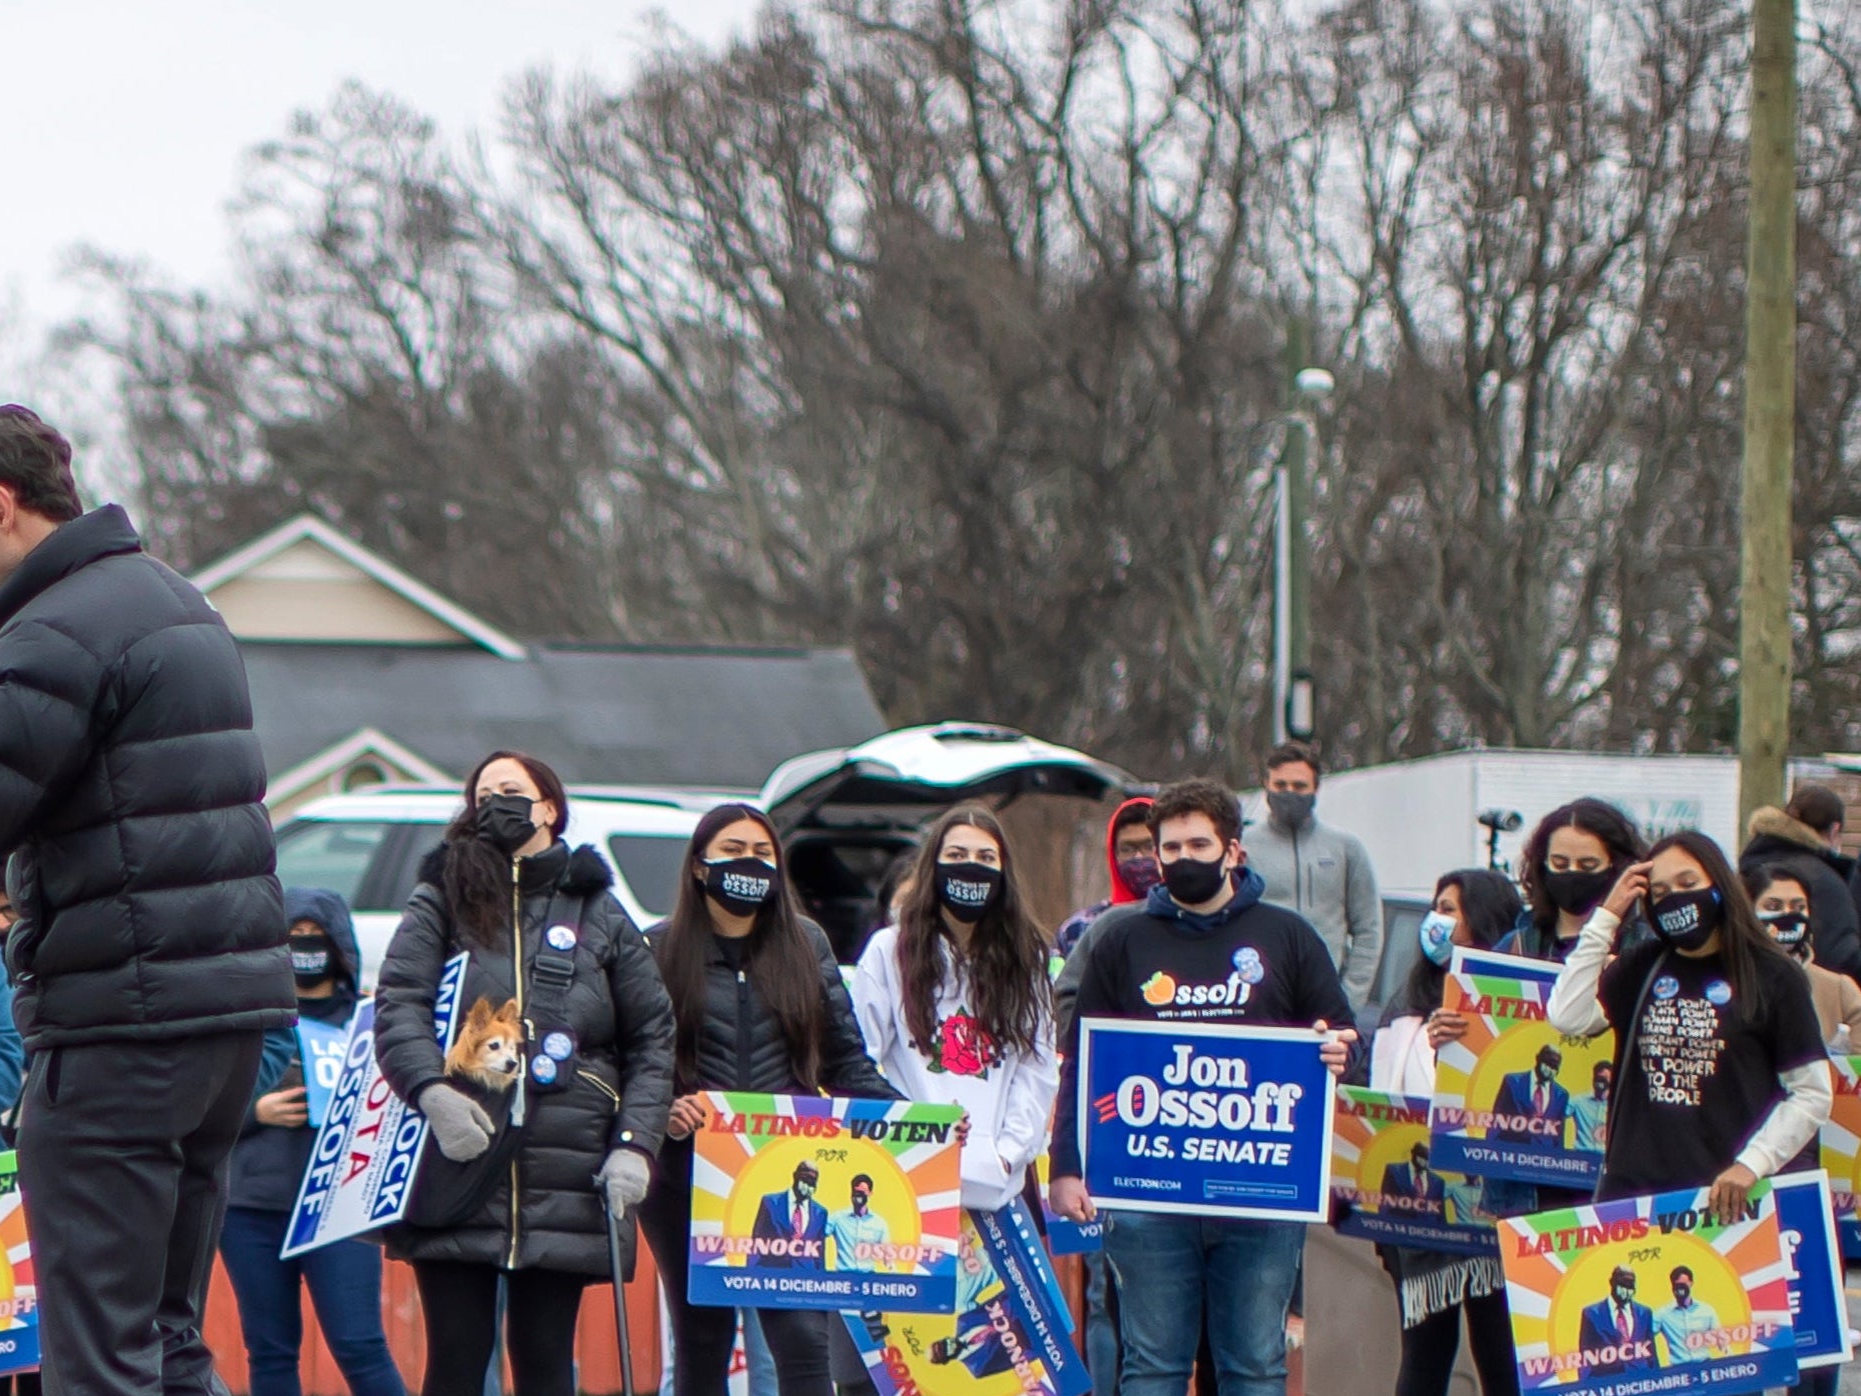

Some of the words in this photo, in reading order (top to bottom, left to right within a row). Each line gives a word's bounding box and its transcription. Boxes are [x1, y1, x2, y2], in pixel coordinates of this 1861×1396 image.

[723, 879, 769, 898] OSSOFF
[1681, 1048, 1717, 1060] POWER
[1689, 1039, 1726, 1050] POWER
[1162, 1044, 1248, 1088] Jon
[1662, 1058, 1716, 1076] POWER
[1648, 1072, 1666, 1086] TO
[1672, 1074, 1698, 1089] THE
[1116, 1075, 1303, 1133] Ossoff
[1649, 1087, 1701, 1106] PEOPLE
[303, 1030, 374, 1216] OSSOFF
[341, 1077, 395, 1186] OTA
[710, 1111, 841, 1137] LATINOS
[849, 1118, 952, 1143] VOTEN
[1437, 1107, 1561, 1136] WARNOCK
[815, 1149, 847, 1163] POR
[1127, 1134, 1175, 1159] U.S.
[1182, 1137, 1292, 1166] SENATE
[1463, 1146, 1498, 1163] VOTA
[1502, 1150, 1514, 1163] 14
[1517, 1154, 1589, 1172] DICIEMBRE
[1334, 1187, 1441, 1213] WARNOCK
[1361, 1217, 1391, 1231] VOTA
[1394, 1222, 1406, 1233] 14
[1408, 1225, 1471, 1241] DICIEMBRE
[1517, 1217, 1649, 1258] LATINOS
[1658, 1198, 1762, 1235] VOTN
[695, 1235, 821, 1258] WARNOCK
[854, 1242, 945, 1263] OSSOFF
[994, 1239, 1007, 1250] 5
[1628, 1247, 1661, 1263] POR
[723, 1276, 761, 1290] VOTA
[763, 1277, 777, 1290] 14
[779, 1279, 852, 1294] DICIEMBRE
[862, 1281, 871, 1295] 5
[872, 1282, 917, 1297] ENERO
[1003, 1255, 1042, 1323] DICIEMBRE
[902, 1326, 923, 1356] POR
[1035, 1320, 1049, 1336] 14
[1688, 1322, 1779, 1351] OSSOFF
[1043, 1335, 1065, 1372] VOTA
[1523, 1341, 1651, 1377] WARNOCK
[1616, 1375, 1690, 1396] DICIEMBRE
[1701, 1369, 1709, 1384] 5
[1712, 1363, 1758, 1381] ENERO
